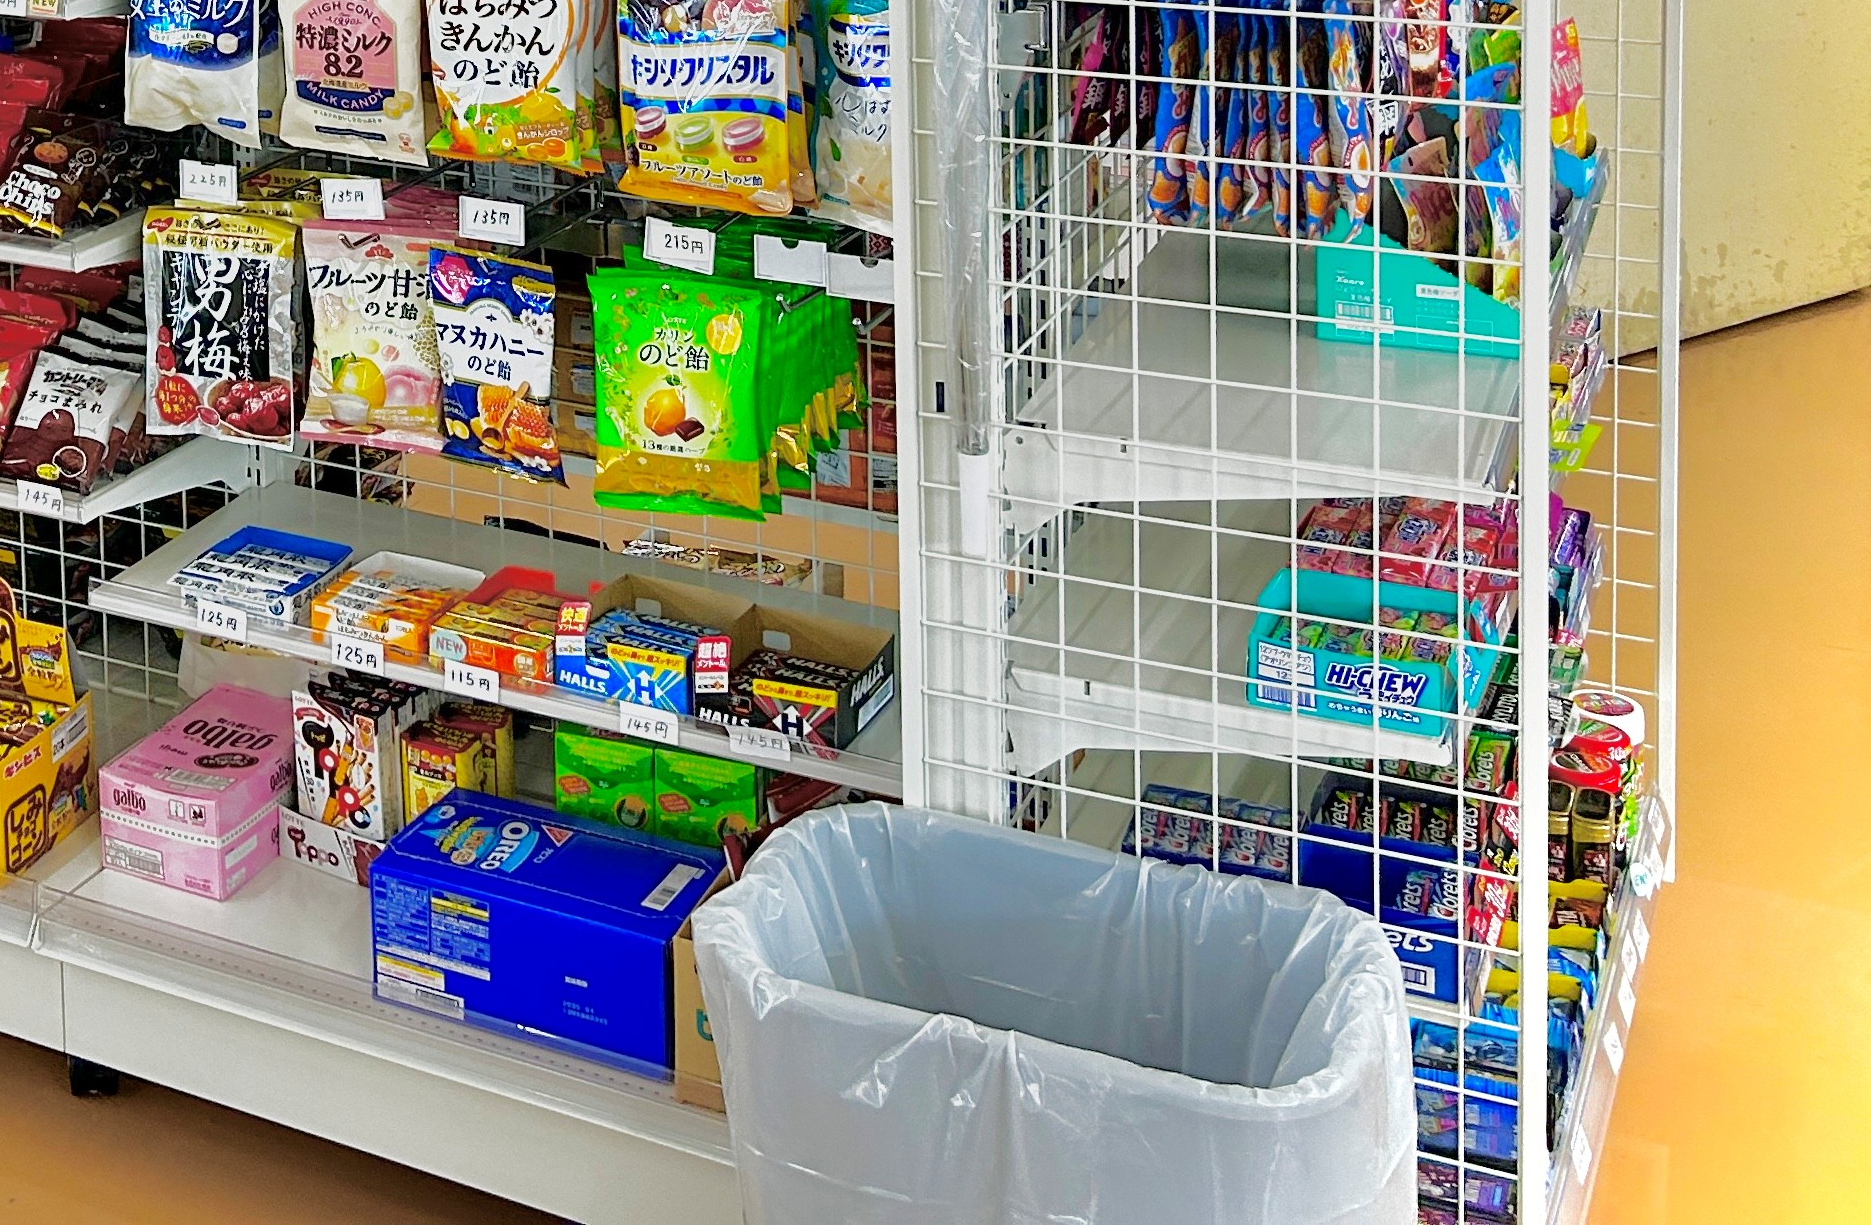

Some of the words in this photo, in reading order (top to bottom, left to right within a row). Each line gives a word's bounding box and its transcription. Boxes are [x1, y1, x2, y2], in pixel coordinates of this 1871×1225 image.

[295, 22, 394, 57] 特濃ミルク
[439, 19, 555, 55] きんかん
[323, 52, 365, 79] 8.2
[453, 56, 540, 89] のど飴
[631, 53, 775, 88] キシリクリスタル
[306, 81, 337, 107] MILK
[339, 90, 384, 110] CANDY
[6, 171, 62, 199] Choco
[190, 173, 227, 188] 225円
[640, 159, 763, 187] フルーツアソートのど飴
[332, 190, 364, 204] 135円
[474, 210, 510, 226] 135円
[665, 235, 704, 254] 215円
[182, 255, 240, 381] 男梅
[366, 301, 419, 321] のど飴
[435, 323, 545, 358] マヌカハニー
[654, 328, 695, 343] カリン
[467, 358, 513, 382] のど飴
[639, 343, 710, 372] のど飴
[28, 390, 104, 415] チョコまみれ
[26, 492, 62, 511] 145円
[201, 608, 238, 631] 125円
[337, 643, 378, 668] 125円
[435, 635, 465, 654] NEW
[697, 641, 727, 659] 超絶
[452, 670, 490, 691] 115円
[559, 669, 606, 694] HALLS
[850, 655, 885, 707] HALLS
[627, 719, 669, 738] 145円
[699, 706, 750, 727] HALLS
[740, 733, 784, 750] 145円
[112, 786, 147, 814] galbo
[479, 819, 531, 872] OREO
